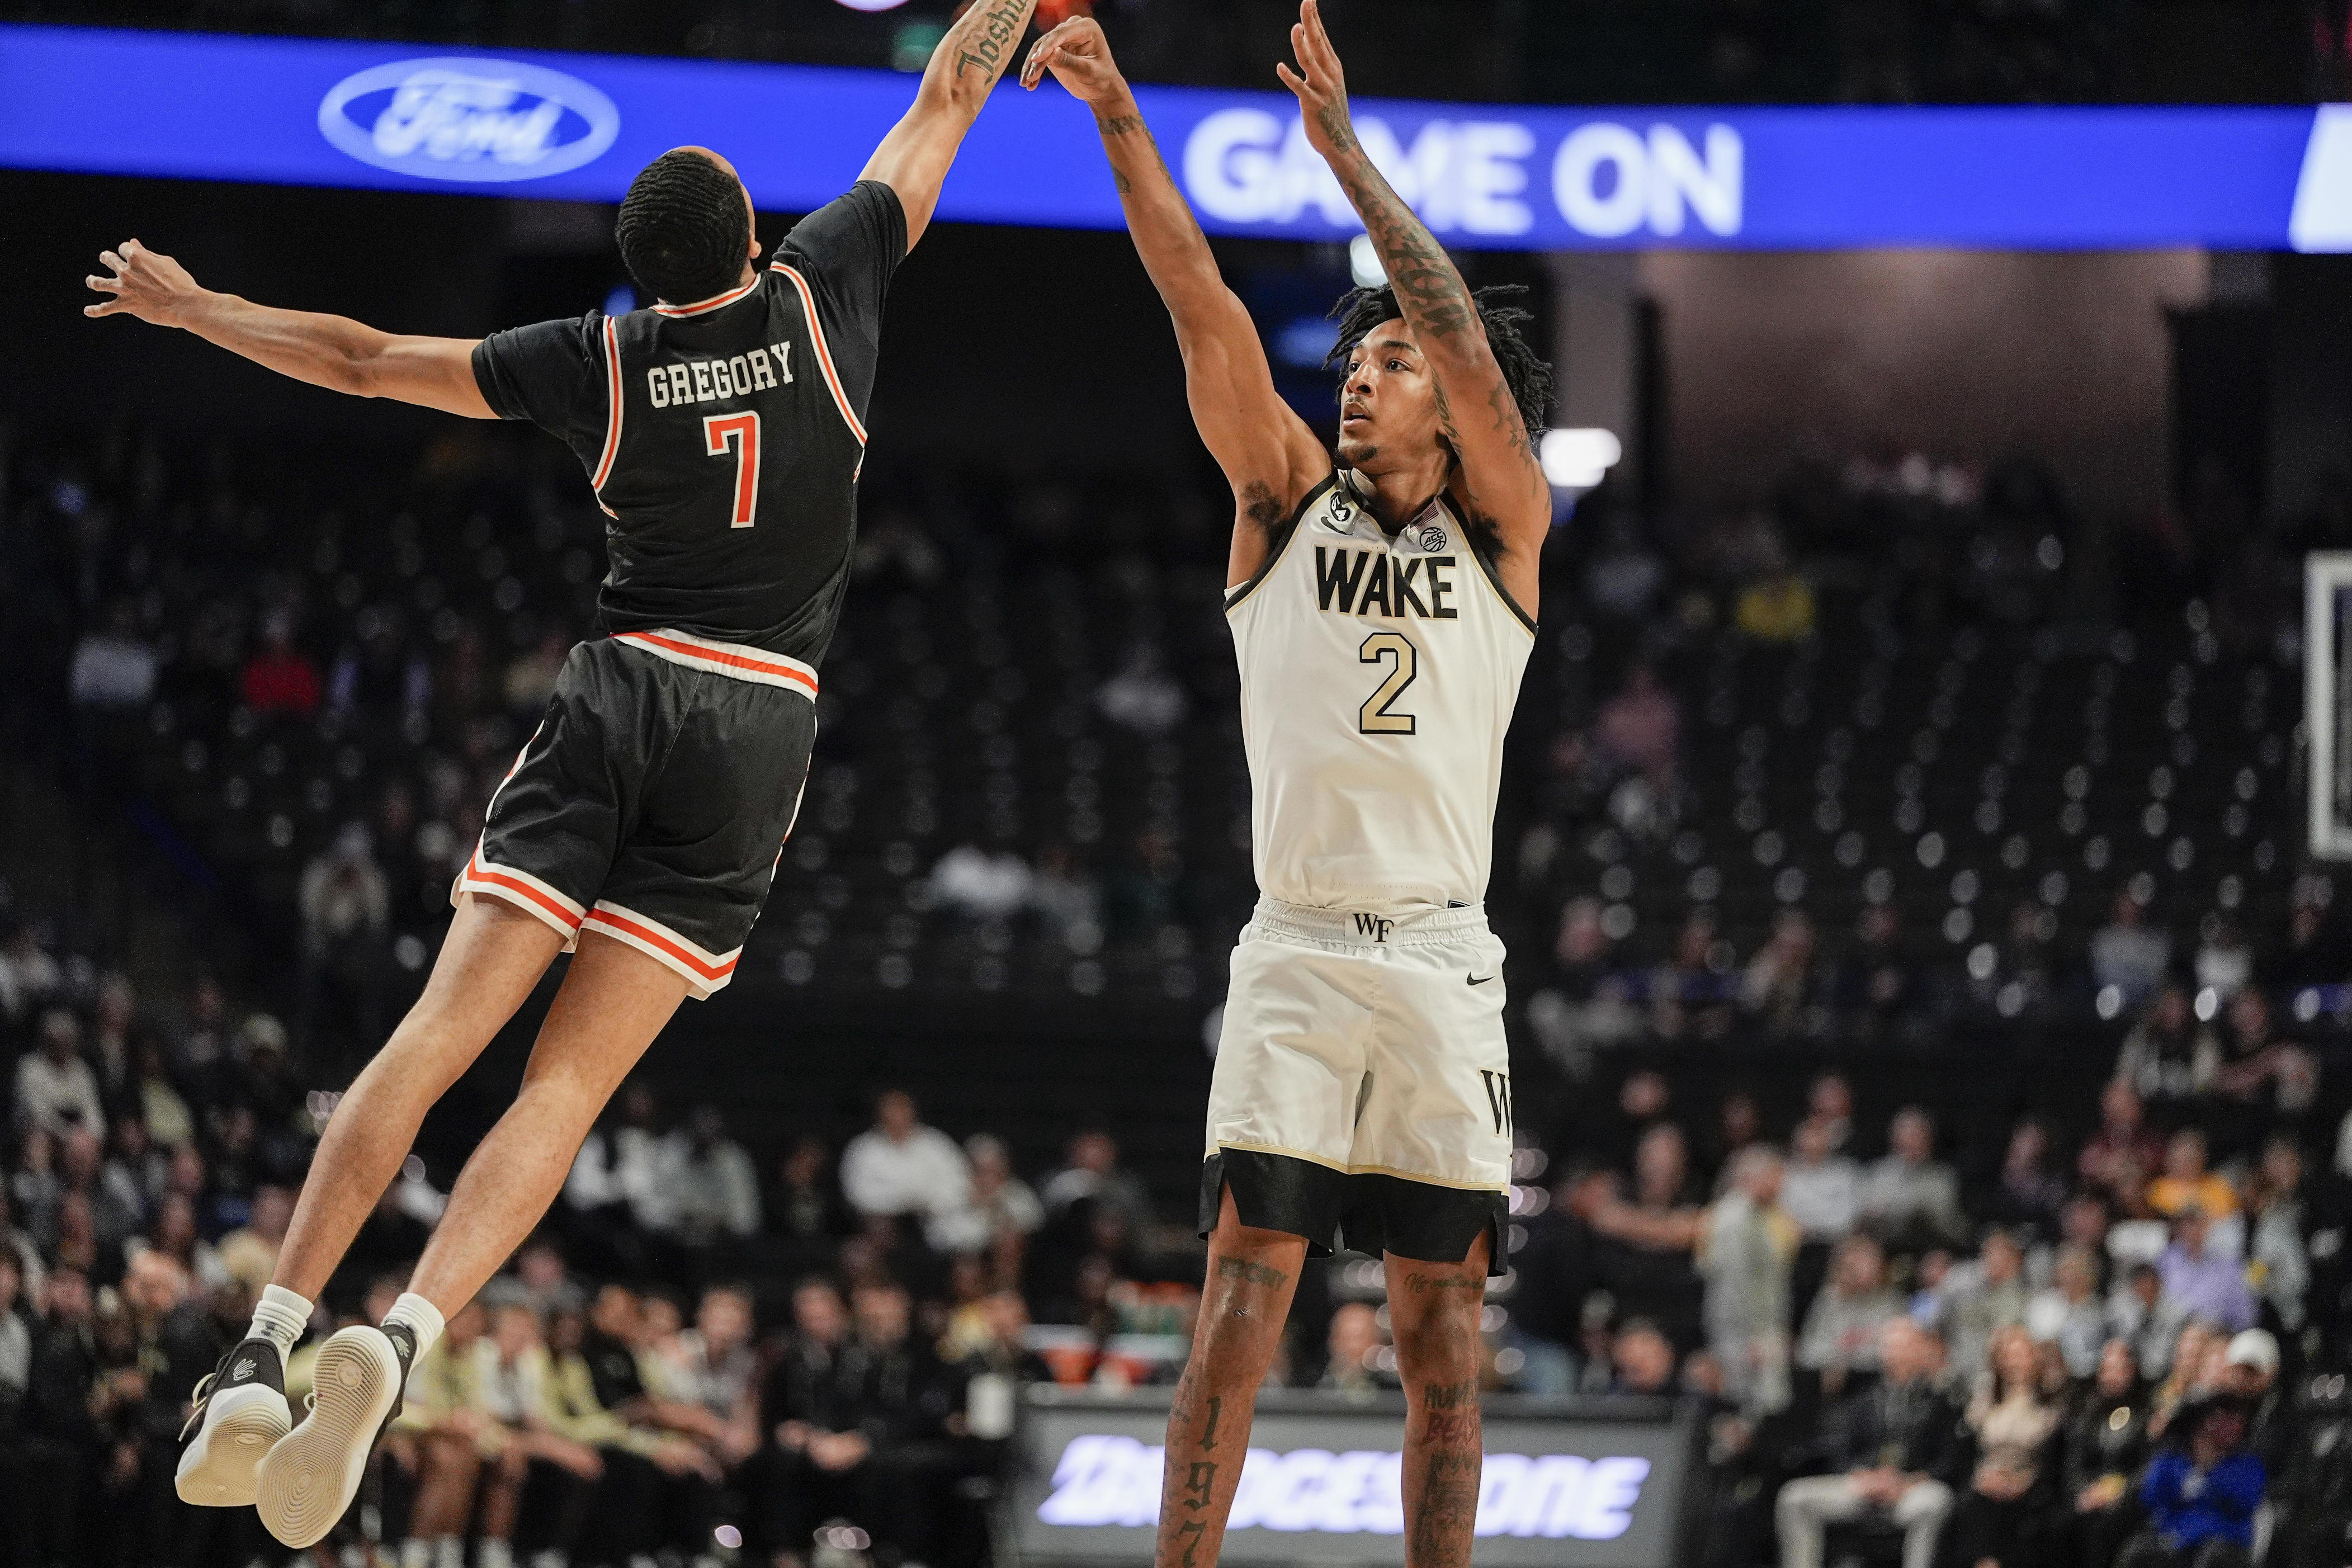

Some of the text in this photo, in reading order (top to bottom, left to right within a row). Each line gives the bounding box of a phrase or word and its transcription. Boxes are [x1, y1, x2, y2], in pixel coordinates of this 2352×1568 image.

[373, 70, 565, 166] Ford
[1183, 109, 1744, 237] GAME ON
[647, 341, 794, 408] GREGORY
[703, 410, 761, 528] 7
[1424, 532, 1444, 545] ACC
[1314, 544, 1458, 621] WAKE
[1359, 632, 1416, 735] 2
[1352, 913, 1394, 942] WF
